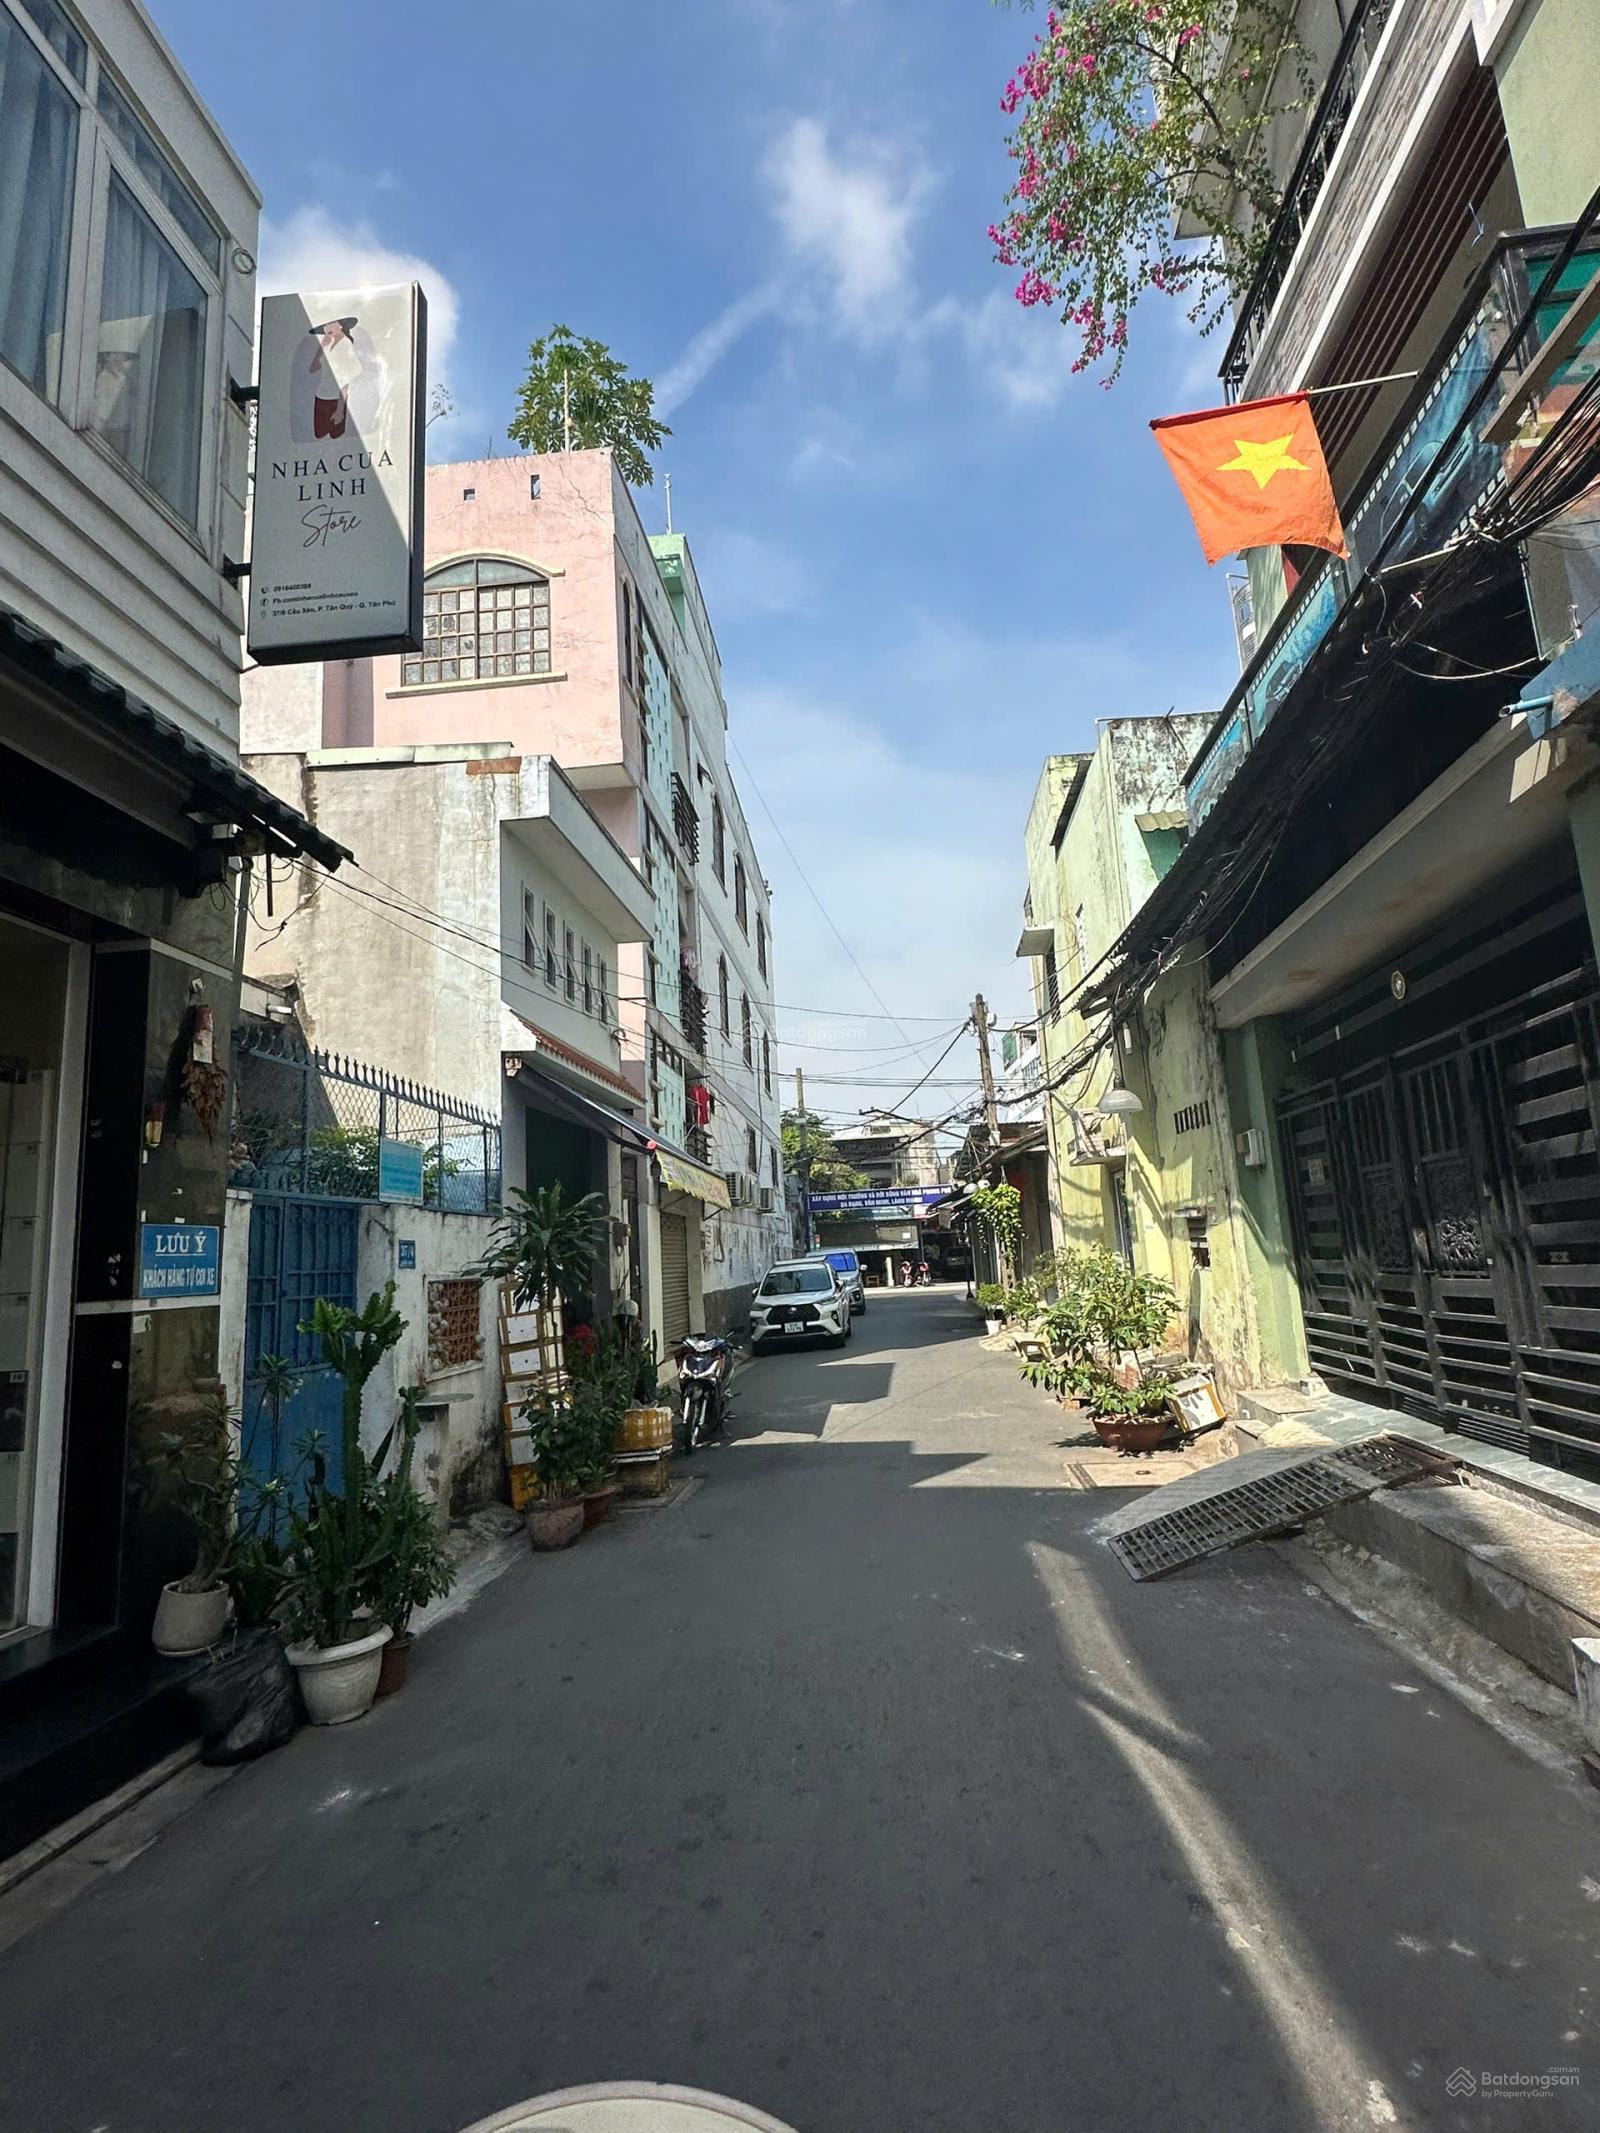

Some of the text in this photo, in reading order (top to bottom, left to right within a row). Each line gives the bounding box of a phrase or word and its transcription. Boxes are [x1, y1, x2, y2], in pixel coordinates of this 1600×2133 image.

[272, 449, 393, 479] NHA CUA
[298, 478, 366, 501] LINH
[301, 504, 362, 548] Store
[155, 1230, 207, 1253] LƯU Ý
[143, 1263, 166, 1288] KHÁCH
[167, 1263, 185, 1288] HÀNG
[186, 1264, 195, 1289] TỰ
